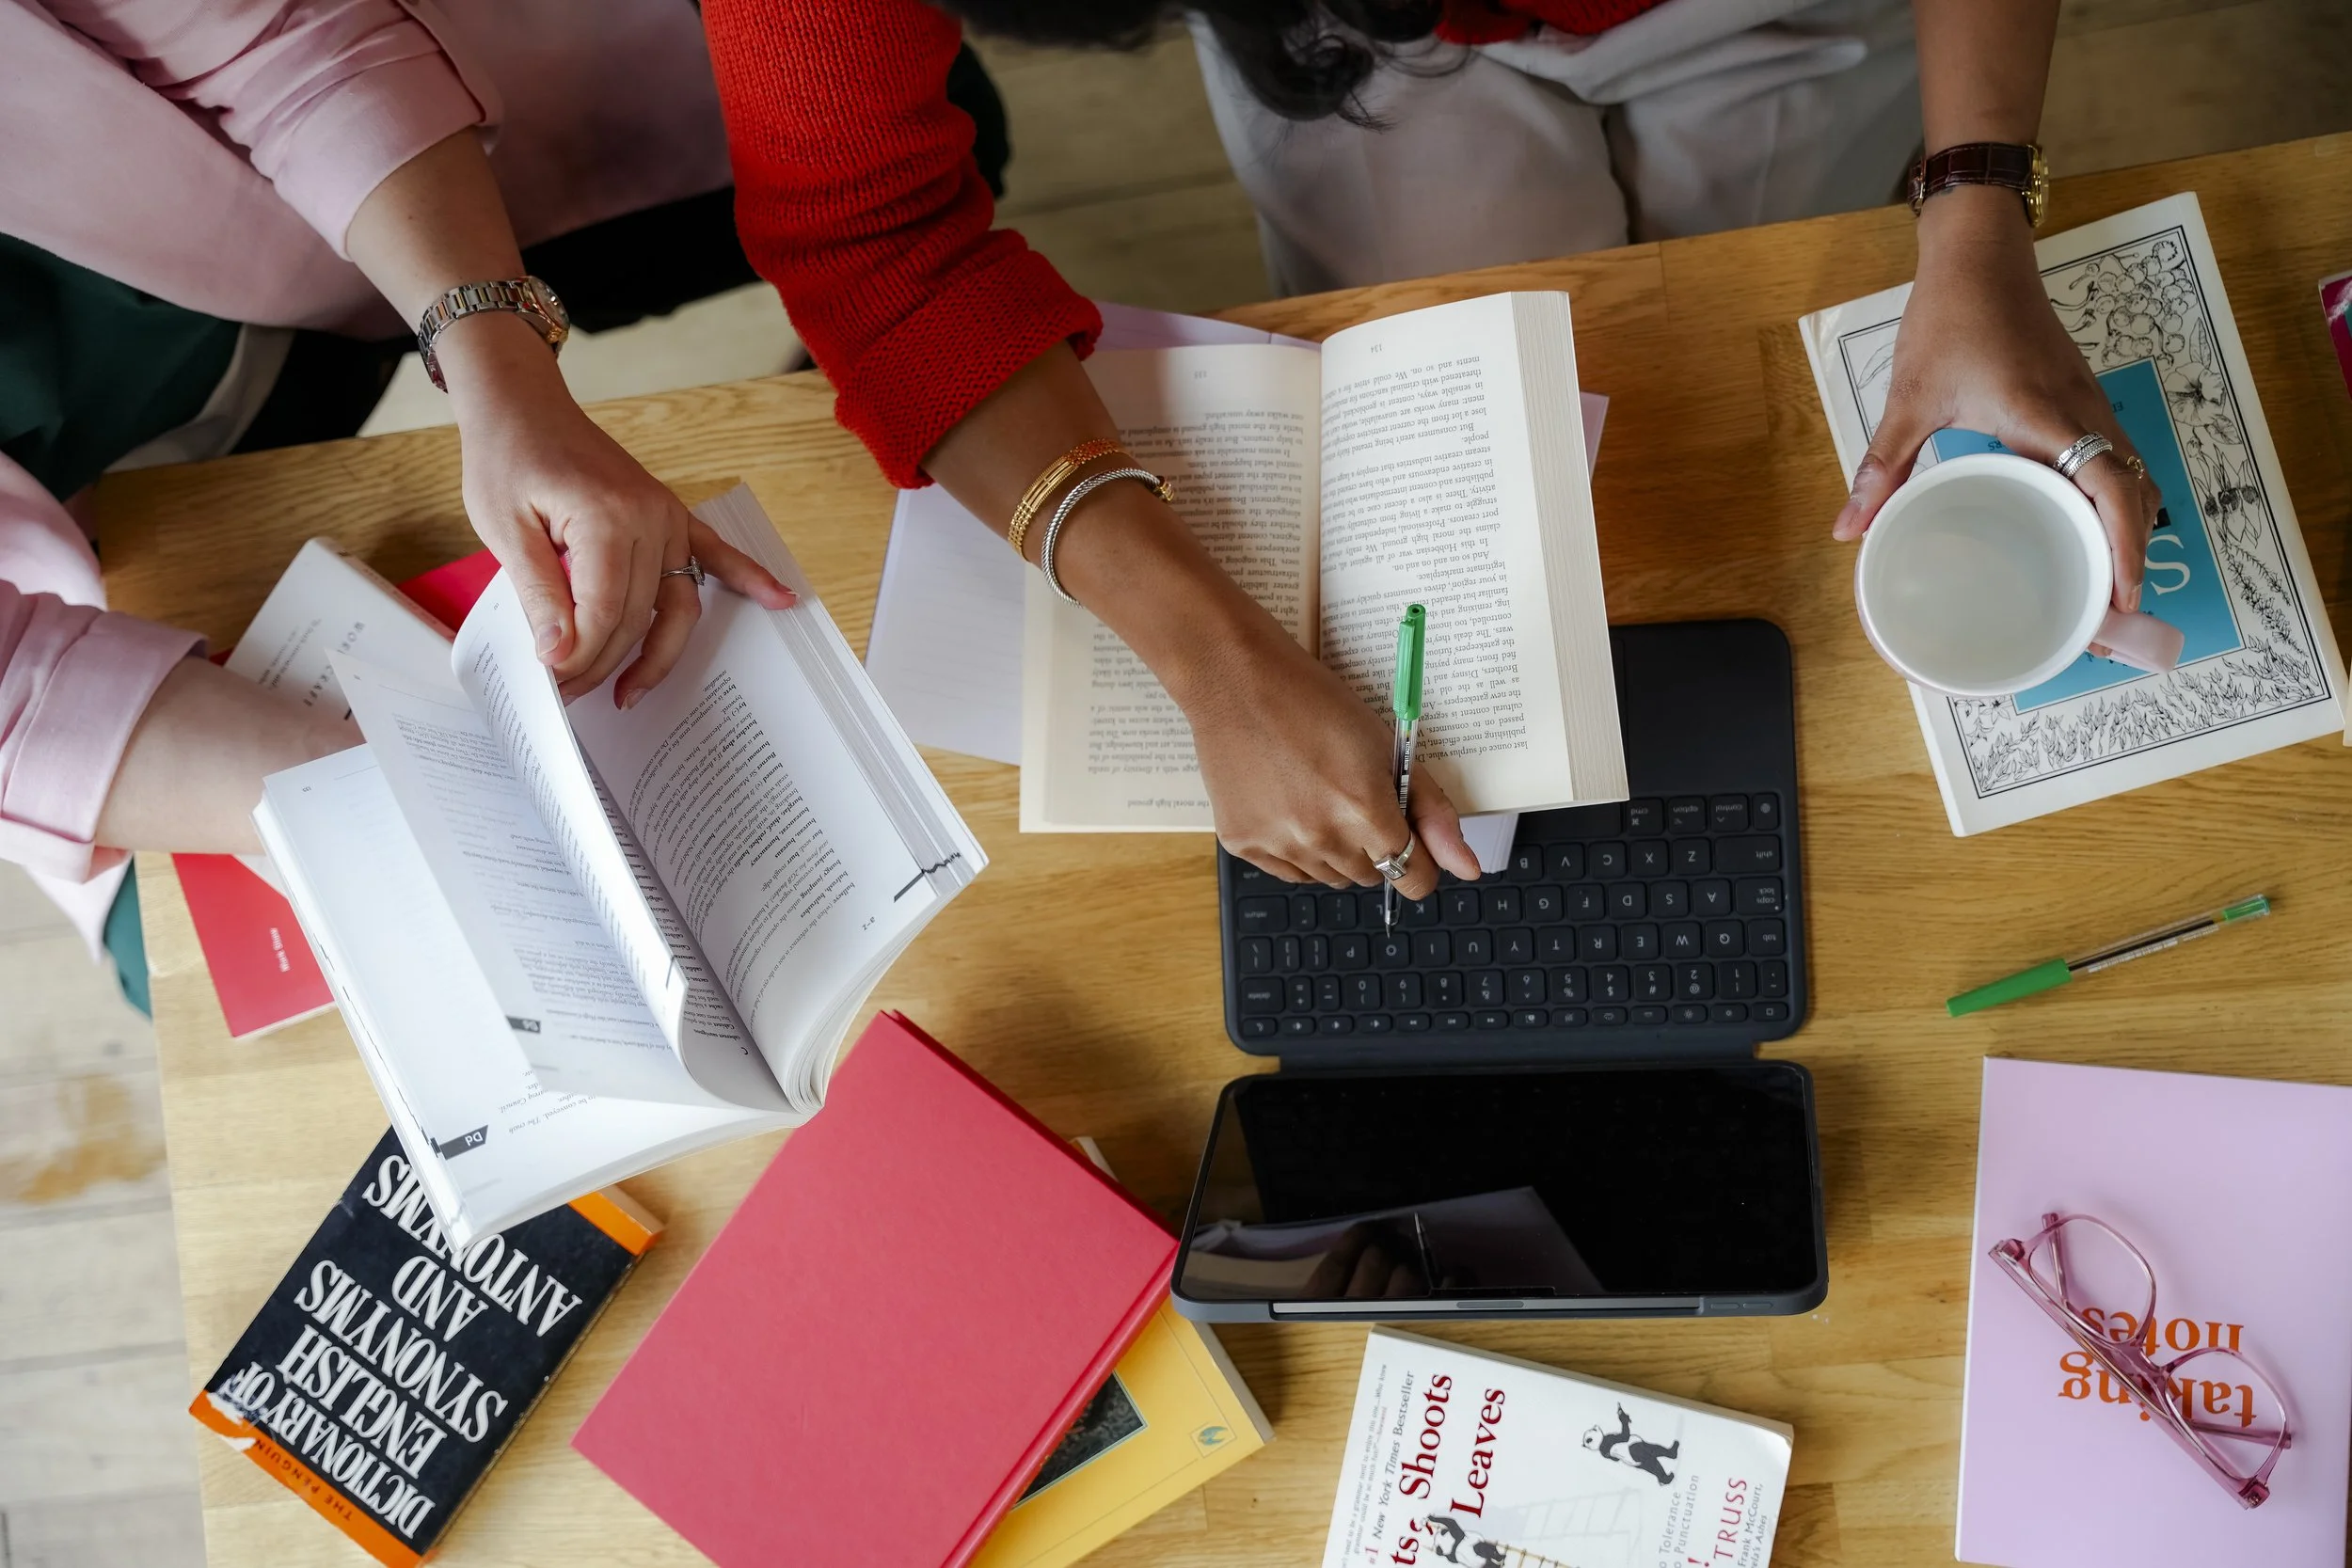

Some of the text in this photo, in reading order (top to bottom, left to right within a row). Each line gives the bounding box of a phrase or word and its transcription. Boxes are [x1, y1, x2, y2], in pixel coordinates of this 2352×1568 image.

[1370, 343, 1383, 354] 134
[1461, 430, 1490, 445] people.
[1398, 507, 1500, 534] port creators. Professional,
[1475, 522, 1501, 532] claims
[1411, 532, 1429, 545] high
[1432, 530, 1454, 542] moral
[1458, 527, 1471, 537] the
[1380, 535, 1408, 551] ground.
[1415, 542, 1457, 556] Hobbesian
[1460, 540, 1476, 549] this
[1398, 549, 1413, 558] war
[1471, 550, 1490, 562] And
[1391, 563, 1405, 572] on.
[1406, 562, 1421, 573] and
[1433, 557, 1448, 568] and
[1416, 560, 1506, 581] legitimate marketplace.
[1433, 664, 1518, 684] Brothers, Disney and
[1460, 702, 1523, 717] cultural content
[1426, 712, 1525, 734] passed consumers.
[1462, 725, 1526, 742] publishing more
[1488, 742, 1513, 752] ounce
[1513, 740, 1529, 750] last
[1449, 746, 1478, 758] surplus
[1519, 857, 1528, 869] B
[1561, 856, 1571, 867] V
[1602, 854, 1613, 865] C
[1645, 852, 1654, 863] X
[1688, 850, 1696, 863] Z
[1538, 897, 1549, 910] G
[1582, 896, 1589, 909] F
[1622, 895, 1632, 907] D
[1665, 894, 1674, 905] S
[1707, 892, 1717, 903] A
[1376, 904, 1383, 914] L
[1416, 903, 1424, 914] K
[1457, 901, 1465, 912] J
[1498, 899, 1508, 911] H
[1552, 939, 1560, 951] T
[1593, 938, 1602, 949] R
[1636, 936, 1645, 948] E
[1676, 935, 1689, 946] W
[1719, 933, 1731, 944] Q
[1346, 946, 1355, 958] P
[1385, 944, 1397, 957] O
[1468, 942, 1479, 953] U
[1511, 941, 1518, 952] Y
[465, 1131, 484, 1147] Dd
[391, 1256, 488, 1342] AND
[2081, 1307, 2244, 1357] notes
[294, 1259, 509, 1443] SYNONYMS
[2058, 1351, 2257, 1428] taking
[276, 1324, 448, 1479] ENGLISH
[1391, 1370, 1415, 1436] Bestseller
[1399, 1373, 1453, 1499] Shoots
[223, 1361, 436, 1540] DICTIONARY OF
[1384, 1439, 1401, 1475] Times
[1449, 1388, 1505, 1518] Leaves
[253, 1438, 353, 1521] THE PENGUIN
[1377, 1480, 1392, 1507] York
[1673, 1475, 1699, 1554] Punctuation
[1743, 1483, 1764, 1534] McCourt,
[1658, 1492, 1681, 1554] Tolerance
[1712, 1477, 1748, 1560] TRUSS
[1372, 1512, 1386, 1541] New
[1755, 1514, 1768, 1544] Ashes
[1737, 1538, 1752, 1568] Frank
